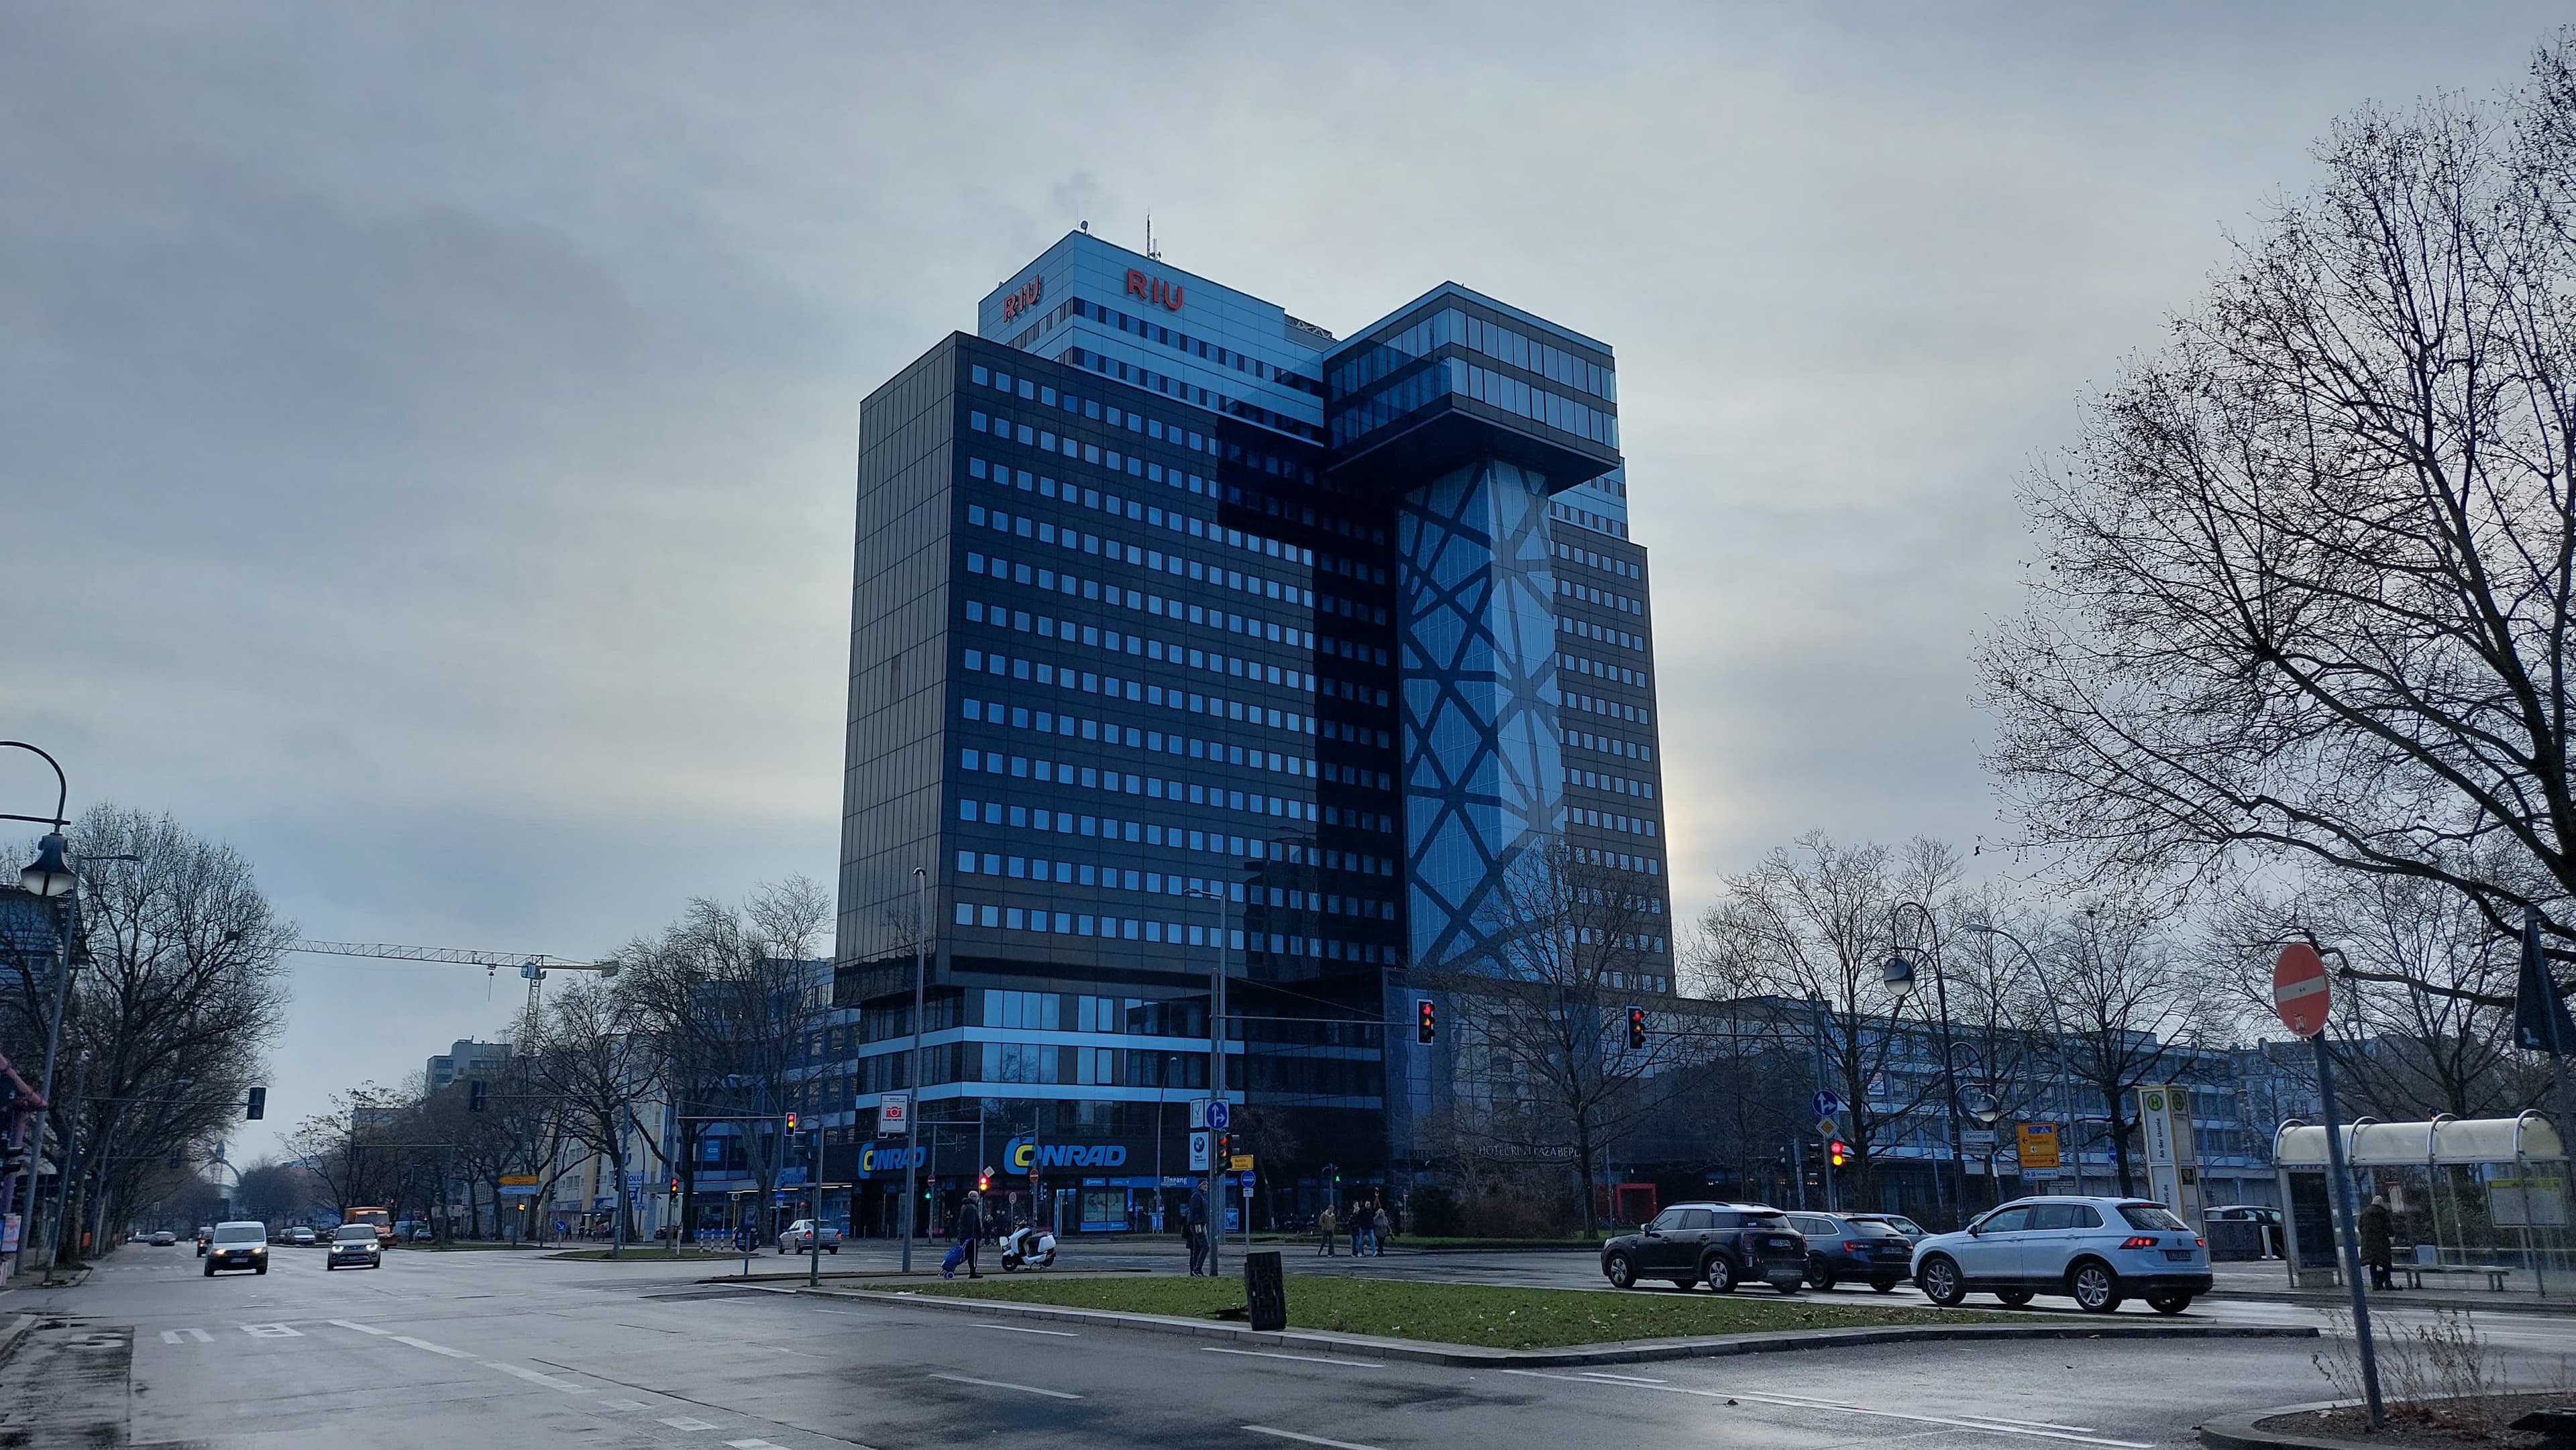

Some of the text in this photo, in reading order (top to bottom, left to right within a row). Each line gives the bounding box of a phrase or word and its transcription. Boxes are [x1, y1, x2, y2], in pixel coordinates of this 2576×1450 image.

[1004, 274, 1040, 323] RIU
[1127, 268, 1183, 311] RIU
[857, 1142, 926, 1178] CONRAD
[1004, 1137, 1127, 1174] CONRAD
[2159, 1150, 2164, 1158] An
